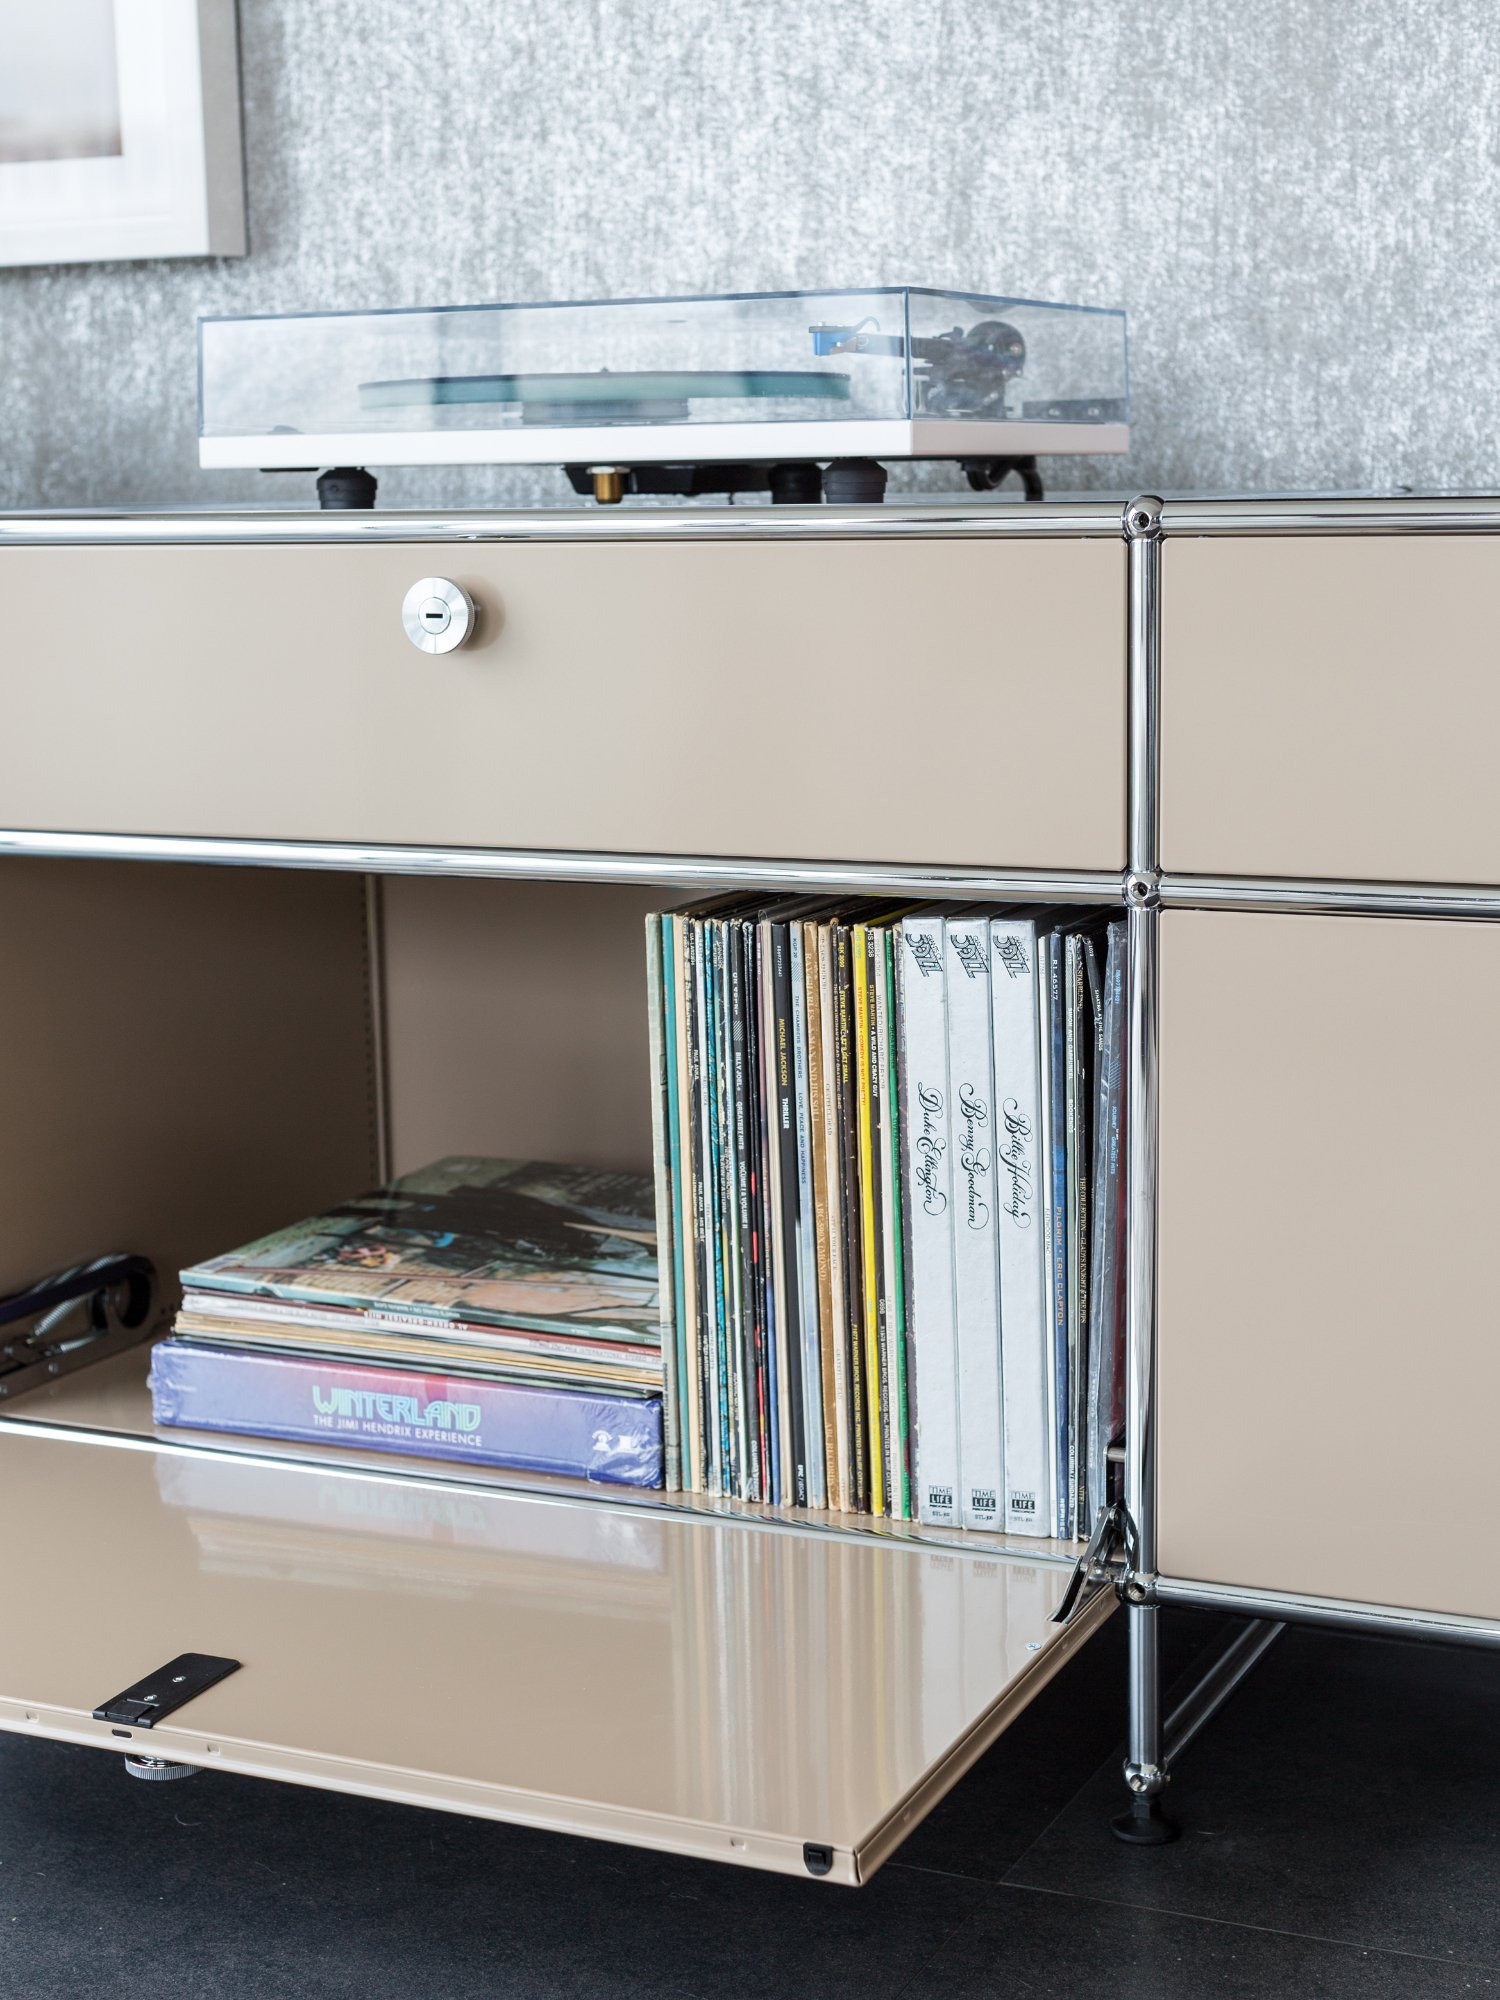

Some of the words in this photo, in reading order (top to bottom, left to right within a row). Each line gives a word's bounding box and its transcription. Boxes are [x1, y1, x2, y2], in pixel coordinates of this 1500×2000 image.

[868, 931, 873, 940] HS
[918, 1082, 943, 1135] Duke
[959, 1083, 988, 1151] Benny
[1003, 1098, 1033, 1160] Billie
[916, 1137, 947, 1215] Ellington
[961, 1148, 991, 1229] Goodman
[999, 1144, 1033, 1228] Holiday
[312, 1385, 481, 1432] WINTERLAND
[313, 1415, 333, 1428] THE
[337, 1418, 359, 1431] JIMI
[362, 1421, 411, 1437] HENDRIX
[415, 1427, 482, 1447] EXPERIENCE
[931, 1495, 951, 1503] LIFE
[1014, 1501, 1033, 1509] LIFE
